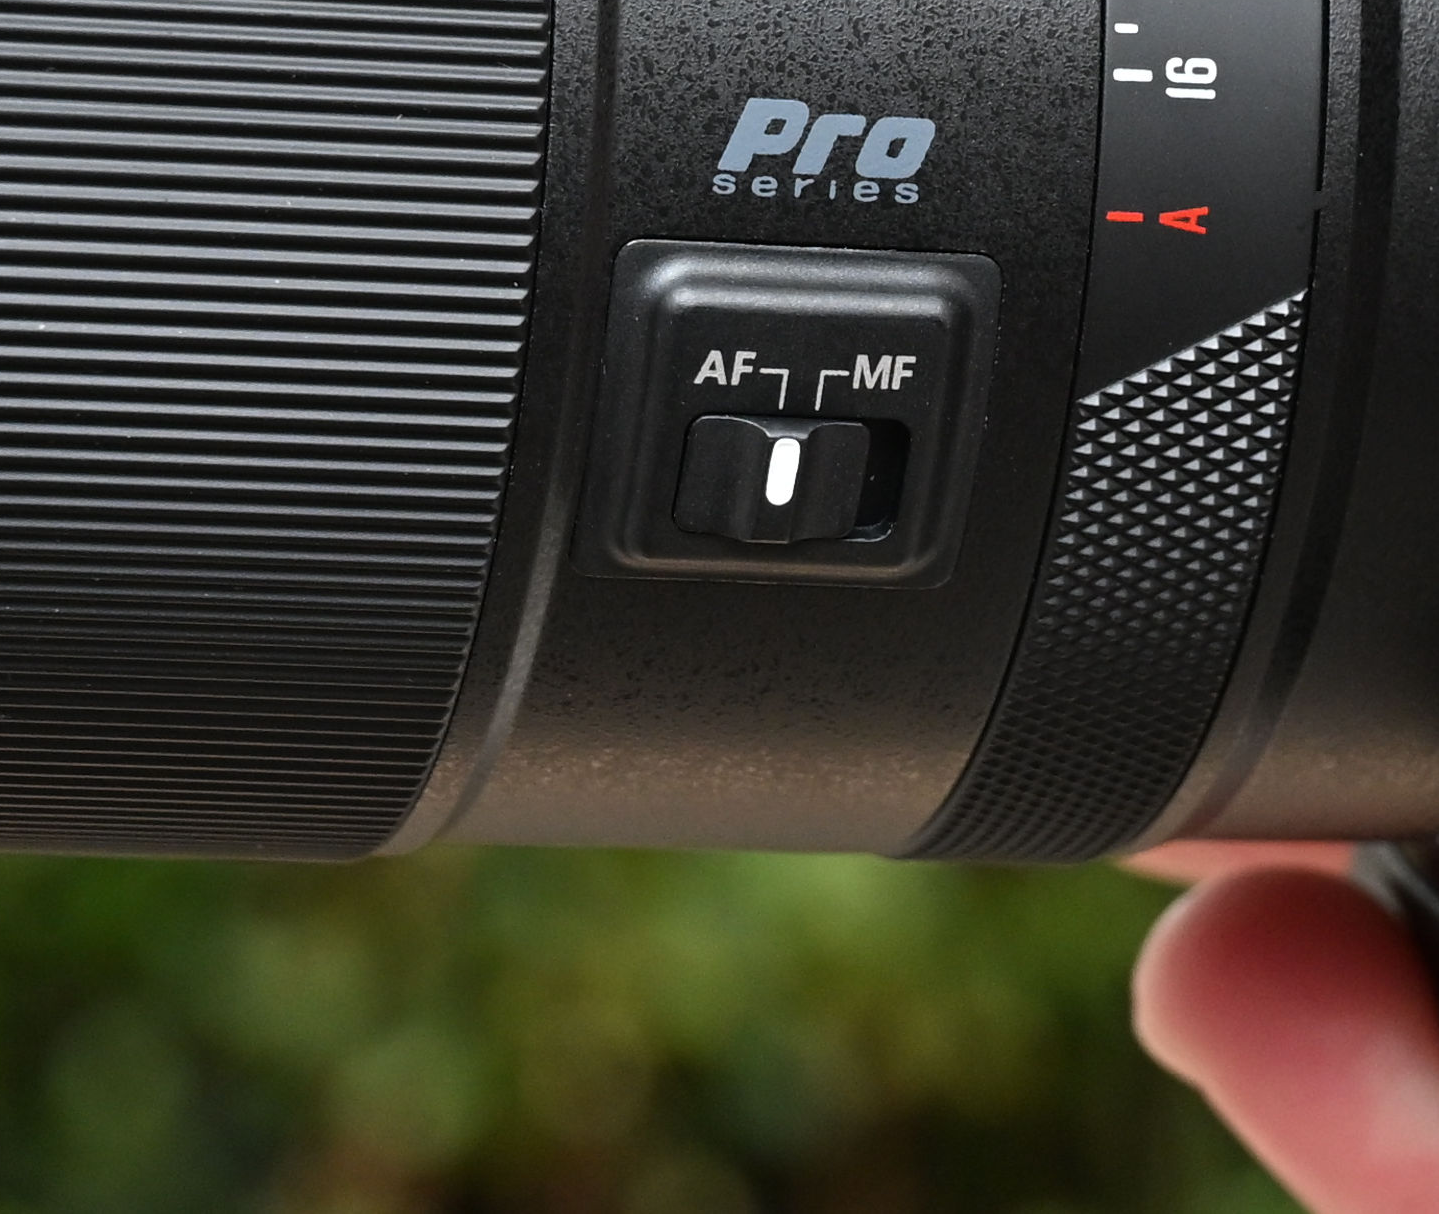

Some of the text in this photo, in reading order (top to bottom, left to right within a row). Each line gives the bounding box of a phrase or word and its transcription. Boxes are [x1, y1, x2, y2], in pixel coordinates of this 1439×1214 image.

[1165, 56, 1218, 100] 16
[717, 97, 936, 179] Pro
[712, 173, 920, 204] series
[1159, 205, 1209, 235] A
[694, 349, 757, 386] AF
[851, 354, 917, 391] MF
